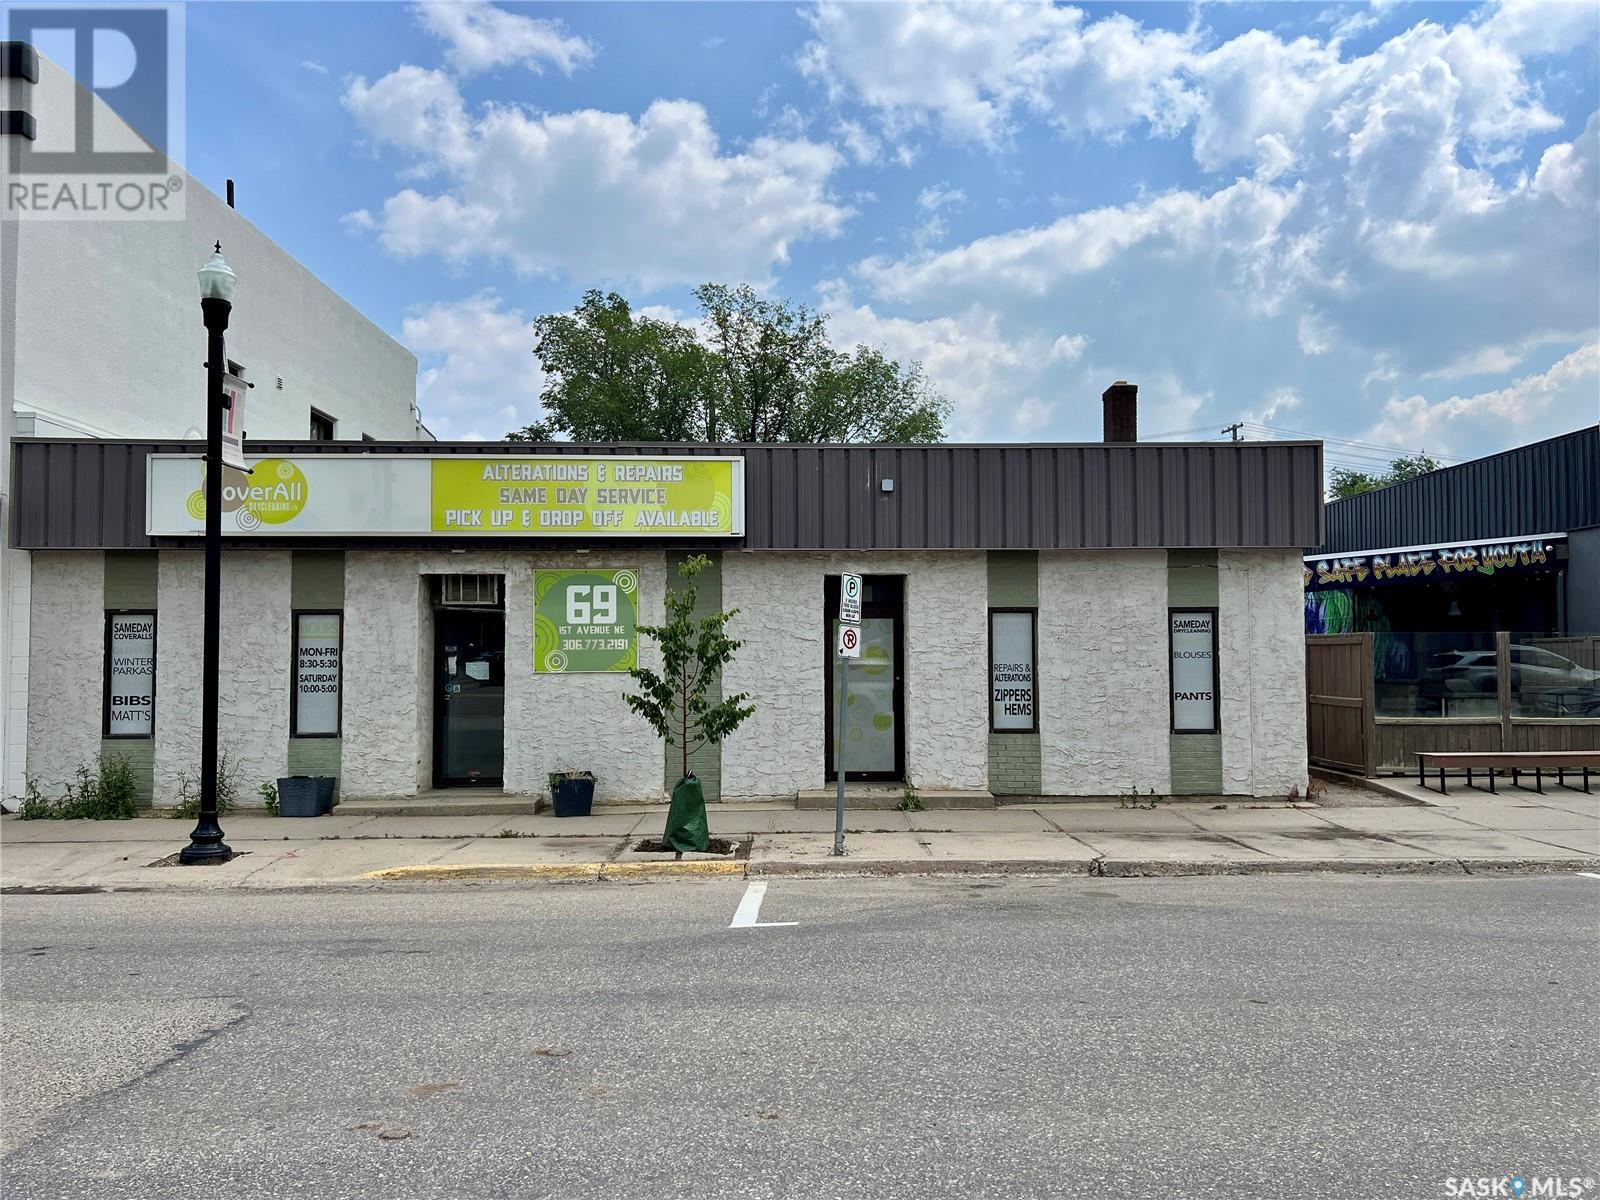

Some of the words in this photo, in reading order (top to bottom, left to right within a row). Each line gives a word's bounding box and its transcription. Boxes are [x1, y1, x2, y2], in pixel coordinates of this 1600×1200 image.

[482, 464, 589, 481] ALTERATIONS
[597, 464, 607, 482] &
[614, 464, 684, 481] REPAIRS
[222, 482, 301, 501] overAll
[499, 487, 548, 504] SAME
[556, 487, 588, 504] DAY
[597, 488, 667, 504] SERVICE
[445, 509, 483, 526] PICK
[491, 509, 513, 526] UP
[522, 509, 531, 527] &
[540, 510, 584, 527] DROP
[592, 509, 624, 527] OFF
[635, 510, 719, 527] AVAILABLE
[1317, 557, 1370, 584] SAFE
[1373, 551, 1436, 580] PLACE
[1438, 546, 1479, 573] FOR
[1477, 541, 1546, 575] YOUTH
[566, 585, 617, 624] 69
[114, 623, 152, 633] SAMEDAY
[301, 623, 338, 634] HOURS
[1173, 620, 1210, 629] SAMEDAY
[559, 626, 572, 634] 1ST
[576, 626, 610, 634] AVENUE
[614, 626, 625, 634] NE
[562, 639, 629, 650] 306.773.2191
[300, 648, 338, 656] MON-FRI
[1174, 651, 1212, 659] BLOUSES
[113, 658, 154, 666] WINTER
[300, 660, 338, 668] 8:30-5:30
[112, 667, 153, 675] PARKAS
[994, 664, 1023, 672] REPAIRS
[1025, 664, 1031, 672] &
[300, 674, 337, 683] SATURDAY
[994, 674, 1032, 682] ALTERATIONS
[300, 685, 337, 693] 10:00-5:00
[994, 689, 1032, 702] ZIPPERS
[1174, 692, 1212, 701] PANTS
[112, 696, 151, 706] BIBS
[1004, 704, 1032, 716] HEMS
[111, 710, 151, 721] MATT'S
